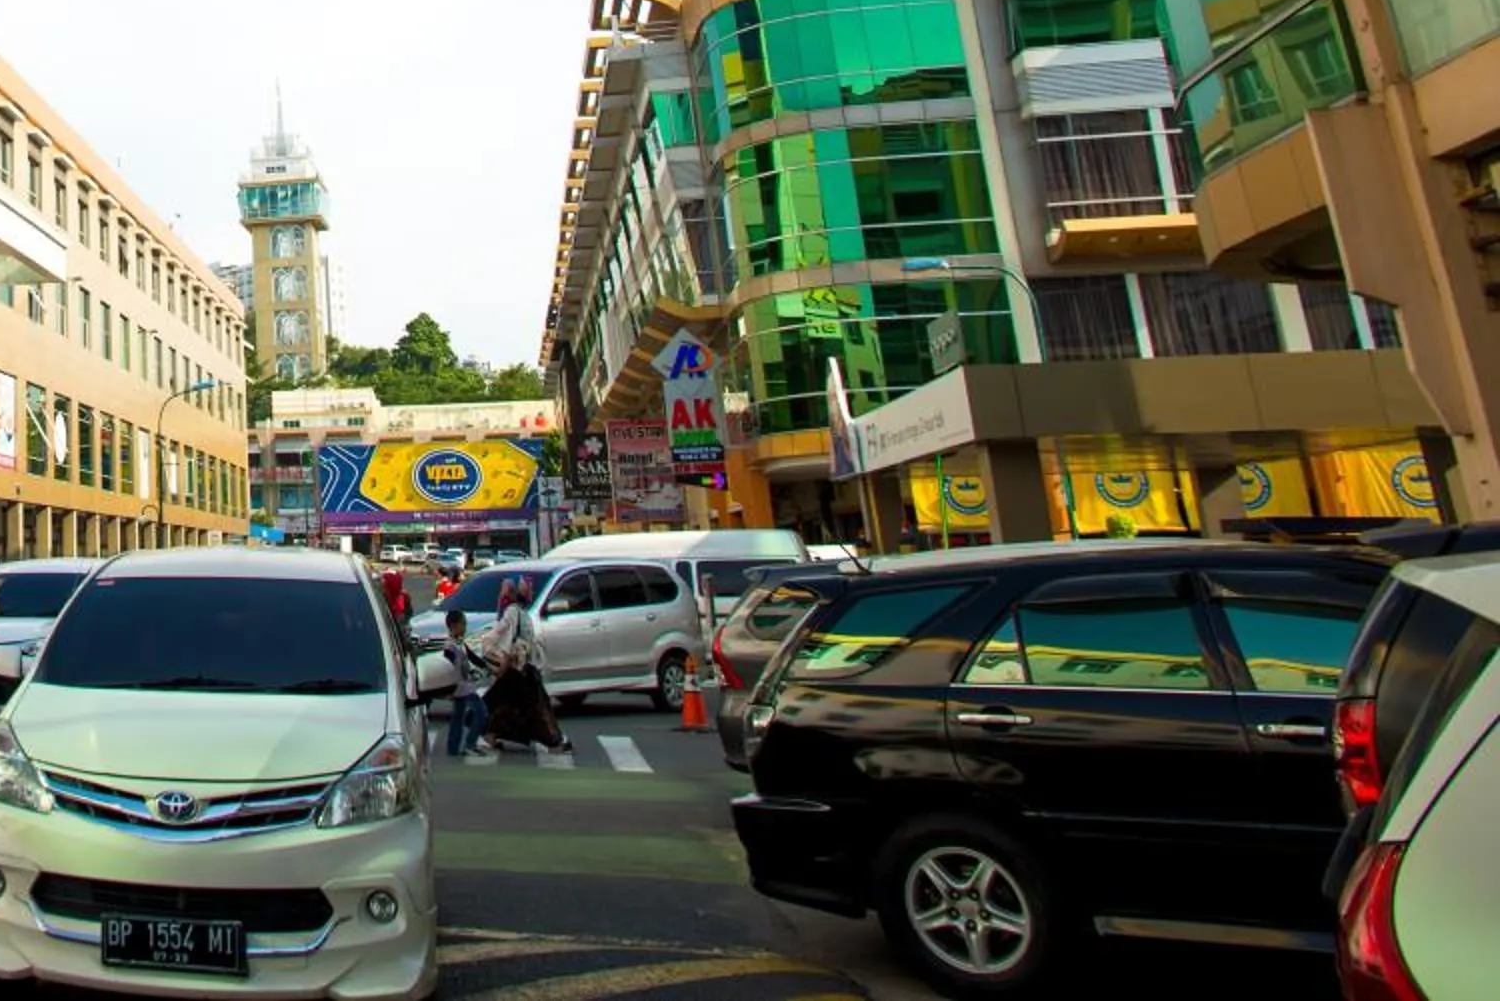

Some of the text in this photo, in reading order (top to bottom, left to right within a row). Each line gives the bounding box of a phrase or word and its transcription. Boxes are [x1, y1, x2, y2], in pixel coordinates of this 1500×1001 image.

[671, 398, 716, 429] AK
[107, 919, 233, 955] BP 1554 MI
